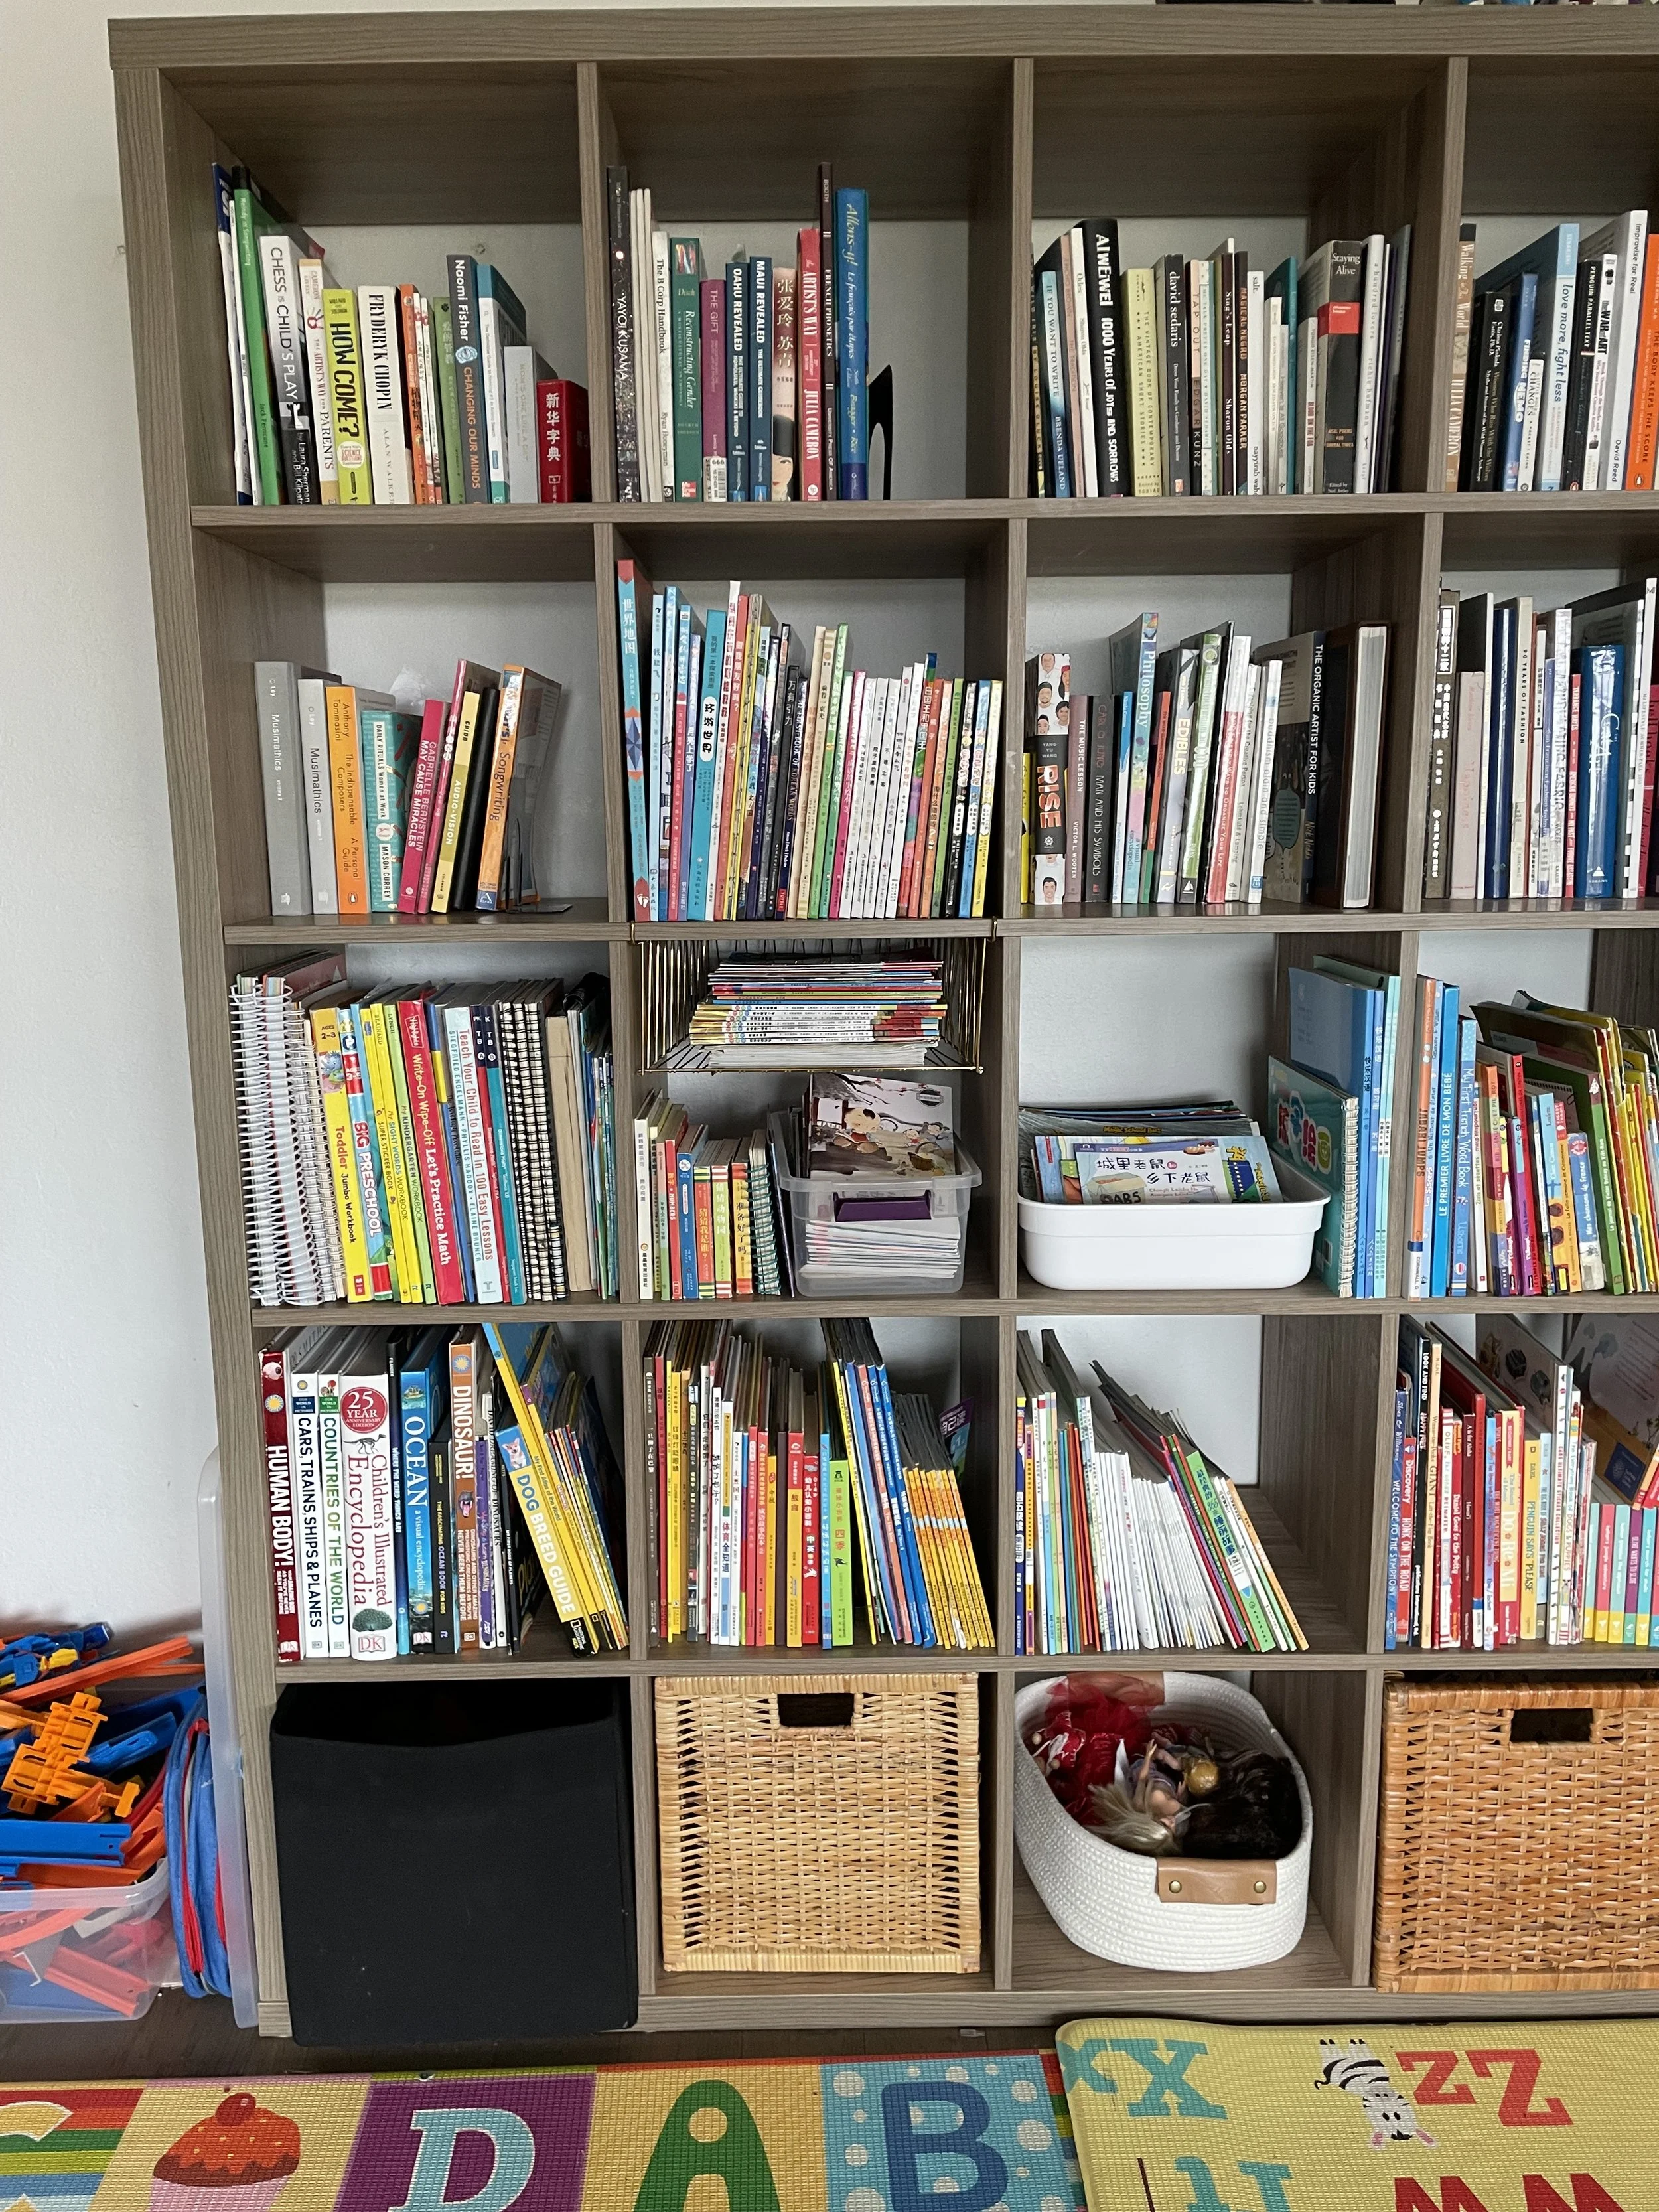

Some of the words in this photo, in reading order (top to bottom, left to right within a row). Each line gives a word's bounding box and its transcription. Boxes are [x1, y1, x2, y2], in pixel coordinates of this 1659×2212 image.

[842, 204, 859, 265] Allons-y!
[1632, 223, 1642, 261] Improvise
[270, 247, 287, 292] CHESS
[756, 261, 765, 291] MAUI
[1332, 253, 1360, 265] Staying
[1336, 265, 1356, 275] Alive
[455, 260, 467, 300] Naomi
[656, 285, 666, 306] Corp
[733, 268, 743, 297] OAHU
[1169, 271, 1180, 303] david
[1561, 284, 1573, 309] love
[1587, 266, 1596, 295] PENGUIN
[616, 296, 628, 328] YAYOI
[756, 293, 766, 343] REVEALED
[777, 279, 794, 327] 张爱玲
[1585, 298, 1594, 329] PARALLEL
[277, 305, 294, 360] CHILD'S
[368, 295, 388, 361] FRYDERYK
[458, 305, 470, 340] Fisher
[658, 309, 668, 354] Handbook
[733, 301, 743, 351] REVEALED
[1170, 307, 1181, 347] sedaris
[1559, 312, 1568, 345] more,
[330, 323, 356, 364] HOW
[617, 331, 628, 380] KUSAMA
[683, 311, 697, 373] Reconstructing
[1555, 348, 1569, 376] fight
[283, 365, 297, 399] PLAY
[374, 365, 392, 409] CHOPIN
[463, 367, 475, 424] CHANGING
[686, 376, 697, 408] Gender
[1554, 380, 1566, 402] less
[334, 371, 359, 437] COME?
[804, 389, 819, 414] JULIA
[468, 429, 478, 451] OUR
[546, 393, 560, 461] 新华字典
[806, 418, 820, 460] CAMERON
[470, 455, 480, 488] MINDS
[1056, 455, 1066, 490] UELAND
[622, 599, 636, 654] 世界地图
[1314, 644, 1323, 664] THE
[784, 680, 796, 727] 万有引力
[1137, 648, 1157, 727] Philosophy
[1311, 666, 1323, 712] ORGANIC
[1520, 692, 1526, 702] OF
[333, 700, 342, 741] Tommasini
[342, 703, 351, 737] Anthony
[702, 703, 715, 753] 环游世界
[1310, 714, 1320, 747] ARTIST
[271, 714, 283, 771] Musimathics
[419, 740, 429, 761] MAY
[1309, 750, 1318, 770] FOR
[310, 748, 323, 813] Musimathics
[336, 767, 346, 811] Composers
[346, 770, 358, 824] Indispensable
[413, 763, 427, 795] CAUSE
[490, 752, 511, 822] Songwriting
[1036, 765, 1062, 829] RISE
[1095, 776, 1104, 795] MAN
[1307, 773, 1317, 794] KIDS
[407, 798, 421, 847] MIRACLES
[445, 780, 462, 845] AUDIO-VISION
[1094, 799, 1104, 817] AND
[1094, 820, 1102, 834] HIS
[1092, 837, 1102, 876] SYMBOLS
[383, 872, 392, 898] CURREY
[459, 1029, 472, 1059] Teach
[412, 1054, 428, 1099] Write-On
[463, 1063, 474, 1084] Your
[1441, 1072, 1453, 1094] BÉBÉ
[465, 1088, 478, 1118] Child
[1442, 1096, 1452, 1121] MON
[354, 1122, 369, 1148] BIG
[419, 1101, 435, 1146] Wipe-Off
[470, 1120, 479, 1128] to
[1442, 1123, 1451, 1136] DE
[335, 1126, 348, 1169] Toddler
[426, 1148, 439, 1177] Let's
[470, 1132, 483, 1157] Read
[1441, 1138, 1451, 1163] LIVRE
[476, 1172, 488, 1189] 100
[1096, 1157, 1165, 1170] 城里老鼠
[1147, 1172, 1210, 1184] 乡下老鼠
[340, 1173, 352, 1200] Jumbo
[358, 1151, 382, 1238] PRESCHOOL
[1439, 1165, 1449, 1204] PREMIER
[428, 1179, 447, 1230] Practice
[477, 1193, 491, 1217] Easy
[716, 1183, 726, 1235] 猜猜动物园
[1439, 1206, 1448, 1216] LE
[344, 1202, 357, 1244] Workbook
[481, 1220, 495, 1260] Lessons
[737, 1202, 747, 1254] 准备好了吗
[436, 1232, 451, 1265] Math
[348, 1391, 374, 1410] 25
[297, 1417, 313, 1459] CARS,
[453, 1385, 475, 1479] DINOSAUR!
[266, 1445, 291, 1511] HUMAN
[323, 1417, 340, 1505] COUNTRIES
[404, 1416, 427, 1507] OCEAN
[299, 1461, 315, 1516] TRAINS,
[370, 1454, 389, 1529] Children's
[327, 1512, 340, 1532] OF
[344, 1455, 372, 1605] Encyclopedia
[415, 1516, 424, 1538] visual
[1400, 1518, 1412, 1542] HONK
[1526, 1501, 1536, 1536] PENGUIN
[271, 1515, 294, 1566] BODY!
[305, 1518, 318, 1558] SHIPS
[328, 1544, 342, 1566] THE
[517, 1474, 539, 1512] DOG
[529, 1512, 557, 1564] BREED
[549, 1564, 575, 1614] GUIDE
[835, 1528, 845, 1551] 四季
[1401, 1543, 1411, 1552] ON
[1526, 1538, 1535, 1559] SAYS
[306, 1562, 319, 1572] &
[374, 1534, 392, 1607] Illustrated
[413, 1540, 425, 1591] encyclopedia
[1400, 1554, 1411, 1568] THE
[330, 1571, 344, 1625] WORLD
[1400, 1569, 1410, 1591] ROAD!
[307, 1573, 322, 1627] PLANES
[388, 2106, 536, 2212] D
[633, 2079, 782, 2212] A
[880, 2080, 1009, 2212] B
